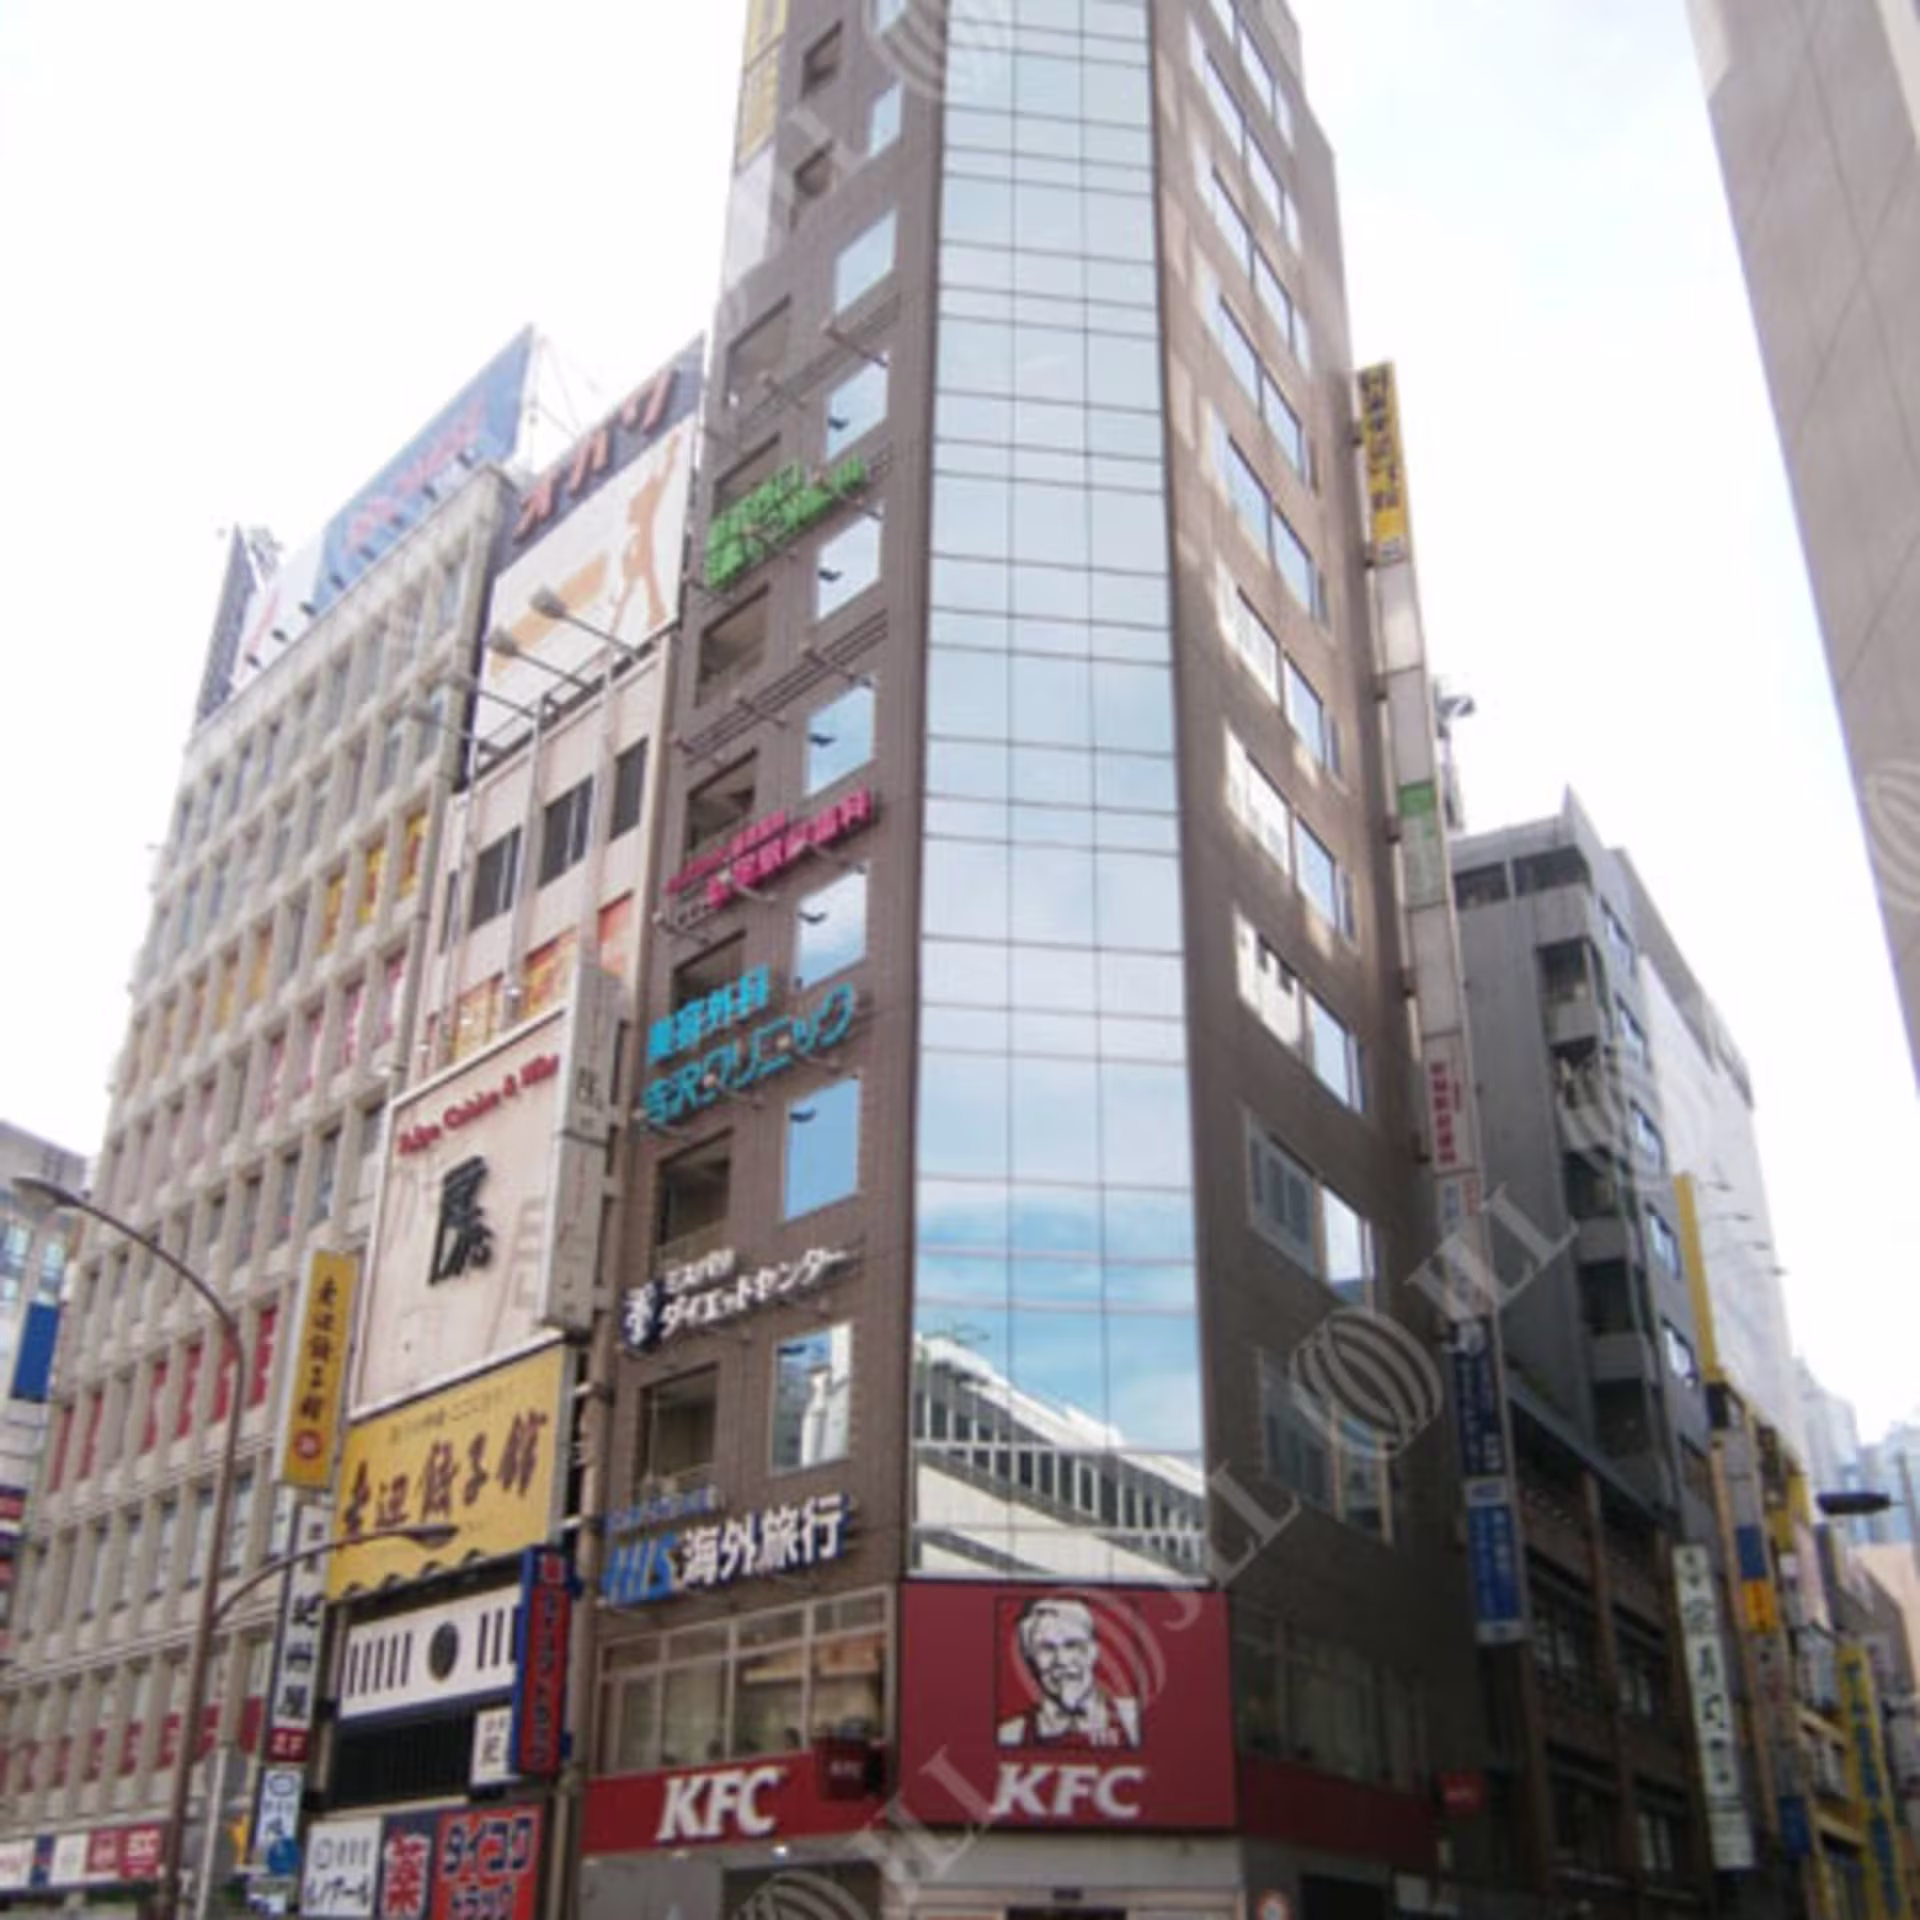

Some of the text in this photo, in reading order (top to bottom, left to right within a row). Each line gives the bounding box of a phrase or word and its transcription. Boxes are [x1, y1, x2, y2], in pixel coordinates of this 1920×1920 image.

[681, 1491, 846, 1587] 海外旅行
[655, 1764, 786, 1843] KFC
[988, 1763, 1146, 1820] KFC
